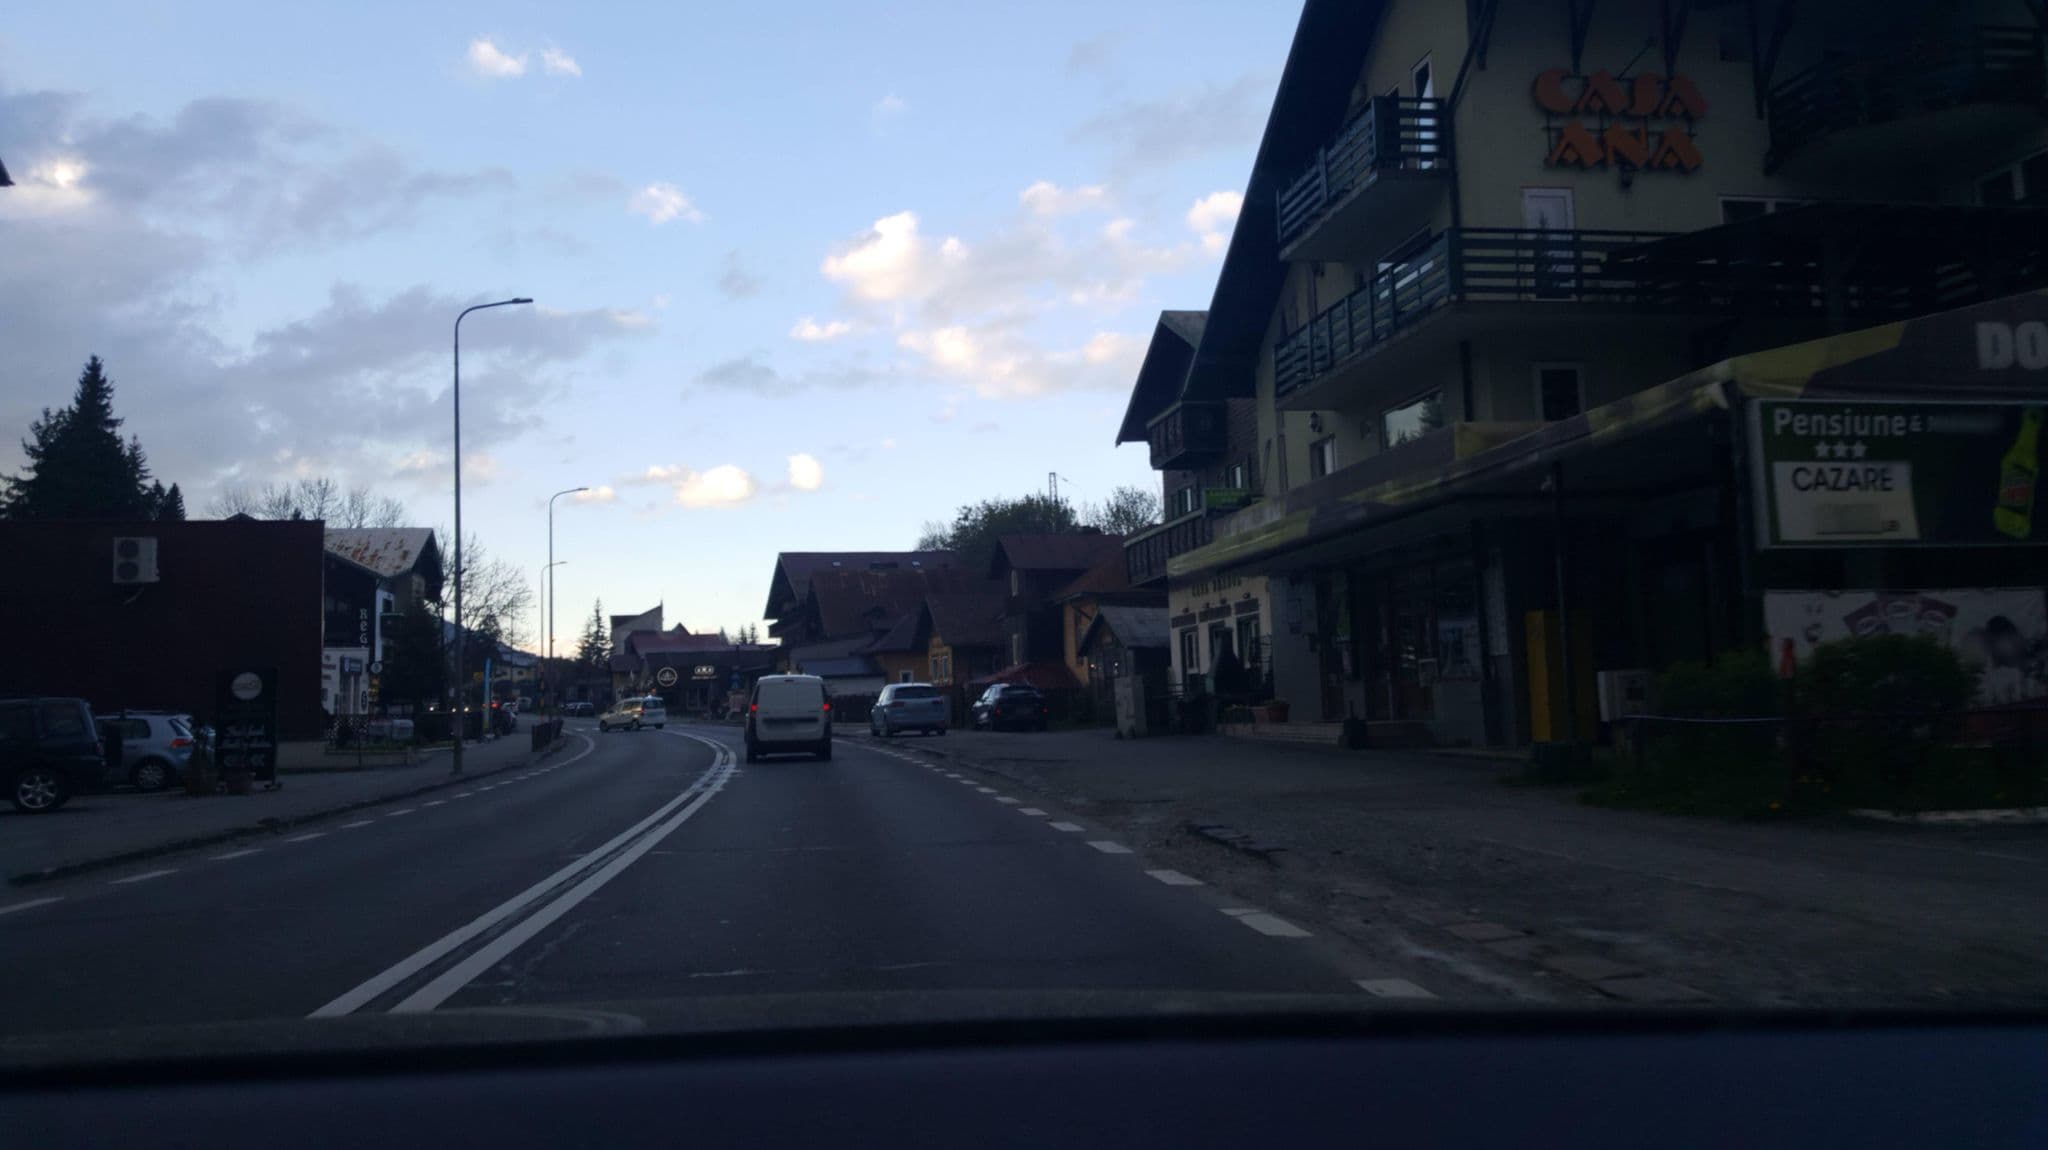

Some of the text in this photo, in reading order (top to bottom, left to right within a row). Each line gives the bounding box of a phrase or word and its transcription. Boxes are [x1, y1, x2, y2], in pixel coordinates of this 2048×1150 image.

[1535, 68, 1708, 118] CASA
[1544, 122, 1704, 170] ANA
[1773, 407, 1907, 436] Pensiune
[1792, 466, 1894, 491] CAZARE
